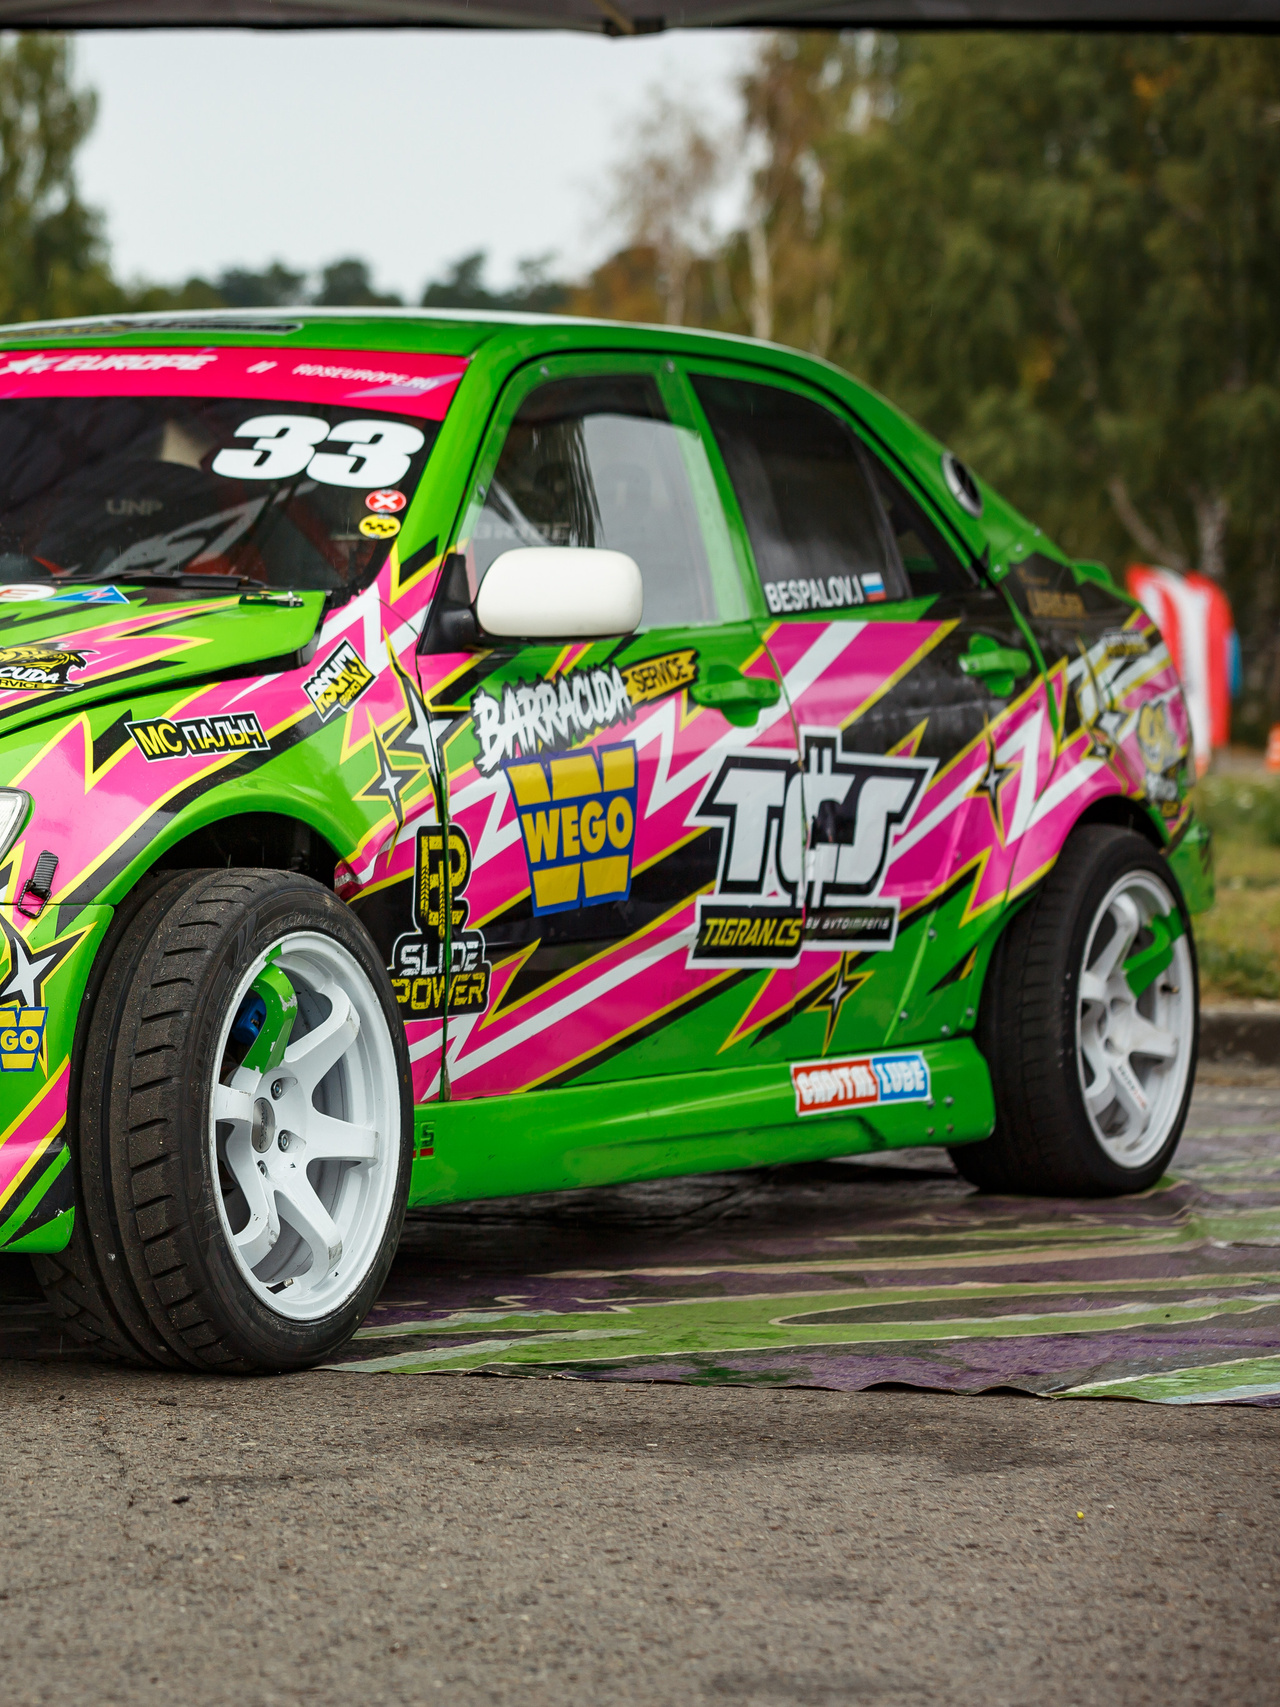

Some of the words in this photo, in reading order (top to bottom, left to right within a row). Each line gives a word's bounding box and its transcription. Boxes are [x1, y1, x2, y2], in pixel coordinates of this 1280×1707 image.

[54, 354, 217, 371] EUROPE
[211, 414, 425, 489] 33
[472, 665, 633, 772] BARRACUDA
[631, 657, 689, 694] SERVICE
[182, 717, 263, 750] ПАЛЫЧ
[521, 795, 634, 864] WEGO
[702, 918, 804, 946] TIGRAN.CS
[399, 941, 480, 977] SLIDE
[391, 972, 486, 1011] POWER
[875, 1059, 925, 1095] LUBE
